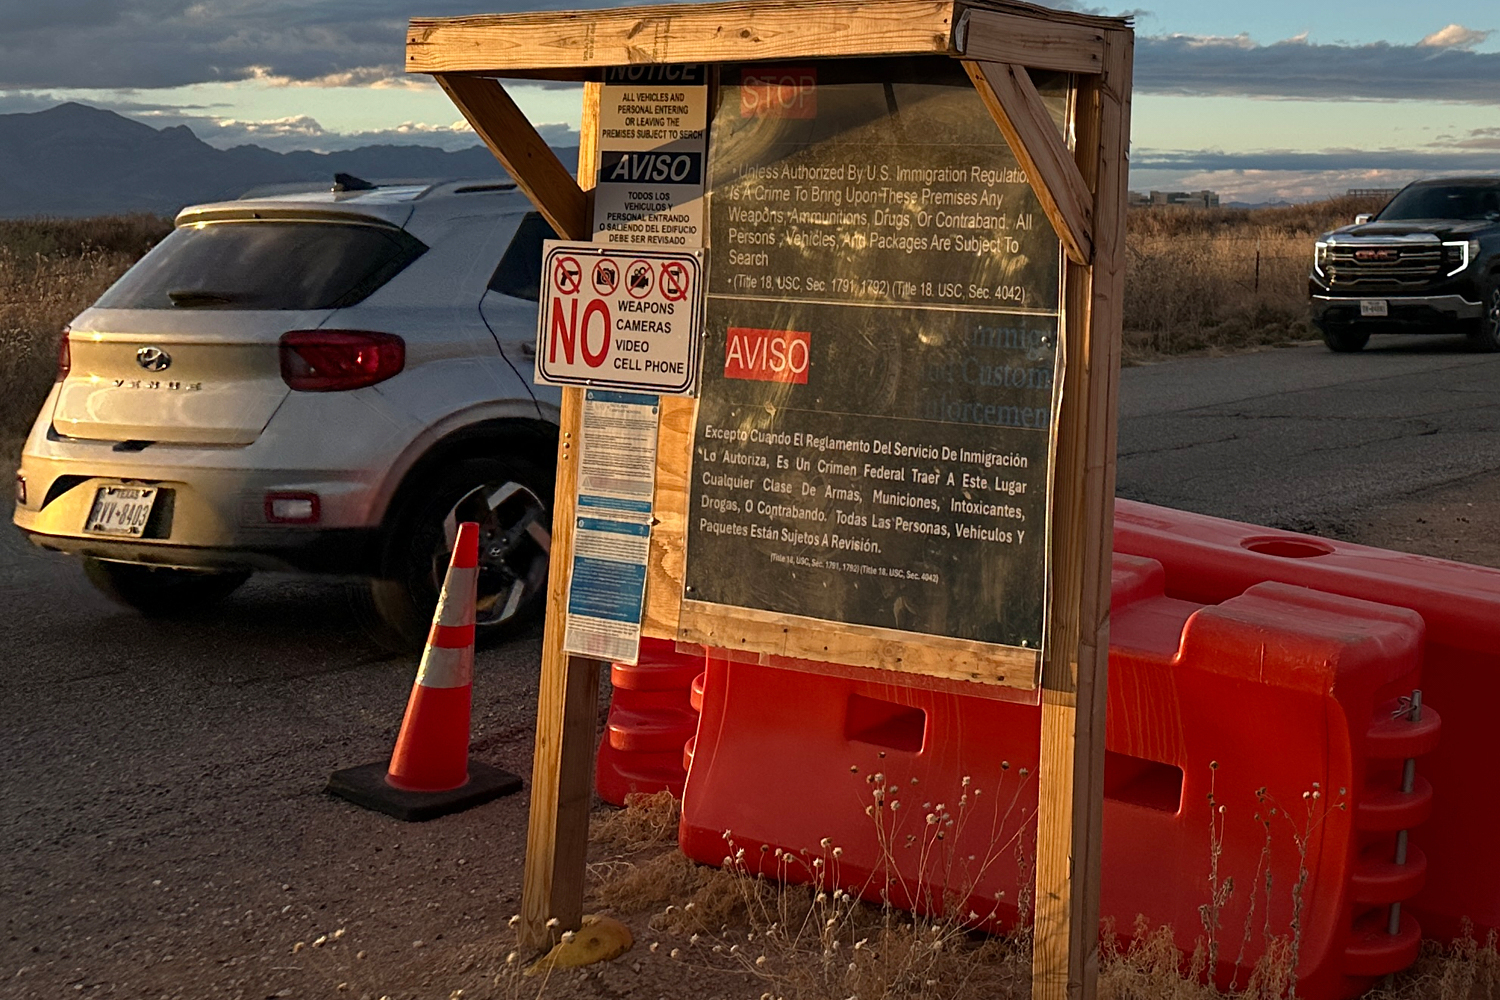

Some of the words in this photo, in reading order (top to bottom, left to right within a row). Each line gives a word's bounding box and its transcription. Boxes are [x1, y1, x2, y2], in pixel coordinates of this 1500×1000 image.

[623, 93, 634, 101] ALL
[636, 93, 667, 102] VEHICLES
[670, 93, 684, 102] AND
[742, 75, 816, 110] STOP
[618, 105, 653, 114] PERSONAL
[655, 105, 688, 114] ENTERING
[625, 117, 634, 126] OR
[637, 117, 665, 126] LEAVING
[667, 118, 679, 126] THE
[602, 130, 634, 139] PREMISES
[636, 130, 667, 139] SUBJECT
[669, 130, 678, 139] TO
[679, 130, 702, 139] SERCH
[611, 155, 691, 181] AVISO
[739, 164, 778, 180] Unless
[781, 164, 843, 180] Authorized
[847, 166, 863, 182] By
[867, 166, 891, 181] U.S.
[897, 166, 967, 184] Immigration
[971, 167, 1030, 185] Regulatio
[625, 202, 664, 211] VEHICULOS
[666, 203, 673, 211] Y
[629, 192, 653, 201] TODOS
[655, 192, 670, 201] LOS
[730, 186, 740, 200] Is
[743, 187, 752, 200] A
[755, 186, 791, 202] Crime
[795, 187, 808, 202] To
[811, 186, 841, 206] Bring
[846, 188, 877, 206] Upon
[881, 189, 918, 204] These
[922, 189, 977, 206] Premises
[980, 190, 1003, 209] Any
[607, 213, 646, 222] PERSONAL
[648, 214, 689, 222] ENTRANDO
[729, 207, 787, 226] Weapons,
[791, 208, 869, 227] Ammunitions,
[875, 210, 911, 230] Drugs,
[918, 212, 933, 228] Or
[936, 212, 1009, 230] Contraband.
[1016, 214, 1032, 231] All
[600, 223, 605, 231] O
[607, 223, 644, 232] SALIENDO
[646, 224, 660, 233] DEL
[662, 225, 697, 234] EDIFUCIO
[609, 234, 630, 243] DEBE
[632, 234, 645, 244] SER
[648, 235, 685, 245] REVISADO
[842, 232, 866, 249] And
[870, 233, 927, 253] Packages
[931, 235, 951, 251] Are
[954, 235, 1000, 255] Subject
[1005, 238, 1019, 254] To
[729, 250, 769, 266] Search
[734, 274, 757, 290] (Title
[777, 276, 803, 293] USC,
[806, 276, 827, 292] Sec.
[861, 278, 890, 296] 1792)
[893, 279, 917, 298] (Title
[938, 283, 966, 299] USC,
[969, 284, 991, 299] Sec.
[995, 285, 1025, 303] 4042)
[549, 297, 611, 368] NO
[618, 300, 674, 314] WEAPONS
[616, 319, 671, 334] CAMERAS
[615, 339, 649, 352] VIDEO
[726, 336, 809, 373] AVISO
[614, 358, 642, 370] CELL
[645, 360, 684, 374] PHONE
[705, 425, 747, 442] Excepto
[750, 428, 790, 446] Cuando
[793, 431, 803, 446] El
[806, 433, 869, 453] Reglamento
[873, 439, 892, 454] Del
[894, 441, 939, 459] Servicio
[941, 445, 957, 460] De
[960, 446, 1028, 468] Inmigración
[704, 449, 717, 462] Lo
[723, 450, 770, 469] Autoriza,
[777, 456, 789, 469] Es
[796, 457, 810, 472] Un
[818, 459, 857, 477] Crimen
[864, 463, 904, 481] Federal
[912, 469, 940, 485] Traer
[947, 471, 955, 486] A
[962, 473, 988, 489] Este
[995, 476, 1027, 495] Lugar
[702, 472, 754, 490] Cualquier
[763, 478, 792, 494] Clase
[802, 482, 816, 496] De
[825, 485, 862, 503] Armas,
[872, 489, 940, 511] Municiones,
[951, 498, 1025, 522] Intoxicantes,
[701, 495, 740, 512] Drogas,
[745, 499, 753, 513] O
[757, 501, 827, 522] Contrabando.
[836, 509, 867, 527] Todas
[872, 514, 891, 530] Las
[895, 517, 950, 537] Personas,
[955, 522, 1012, 542] Vehículos
[1017, 530, 1025, 544] Y
[700, 518, 748, 537] Paquetes
[750, 523, 778, 540] Están
[781, 527, 819, 547] Sujetos
[822, 533, 829, 547] A
[831, 535, 881, 554] Revisión.
